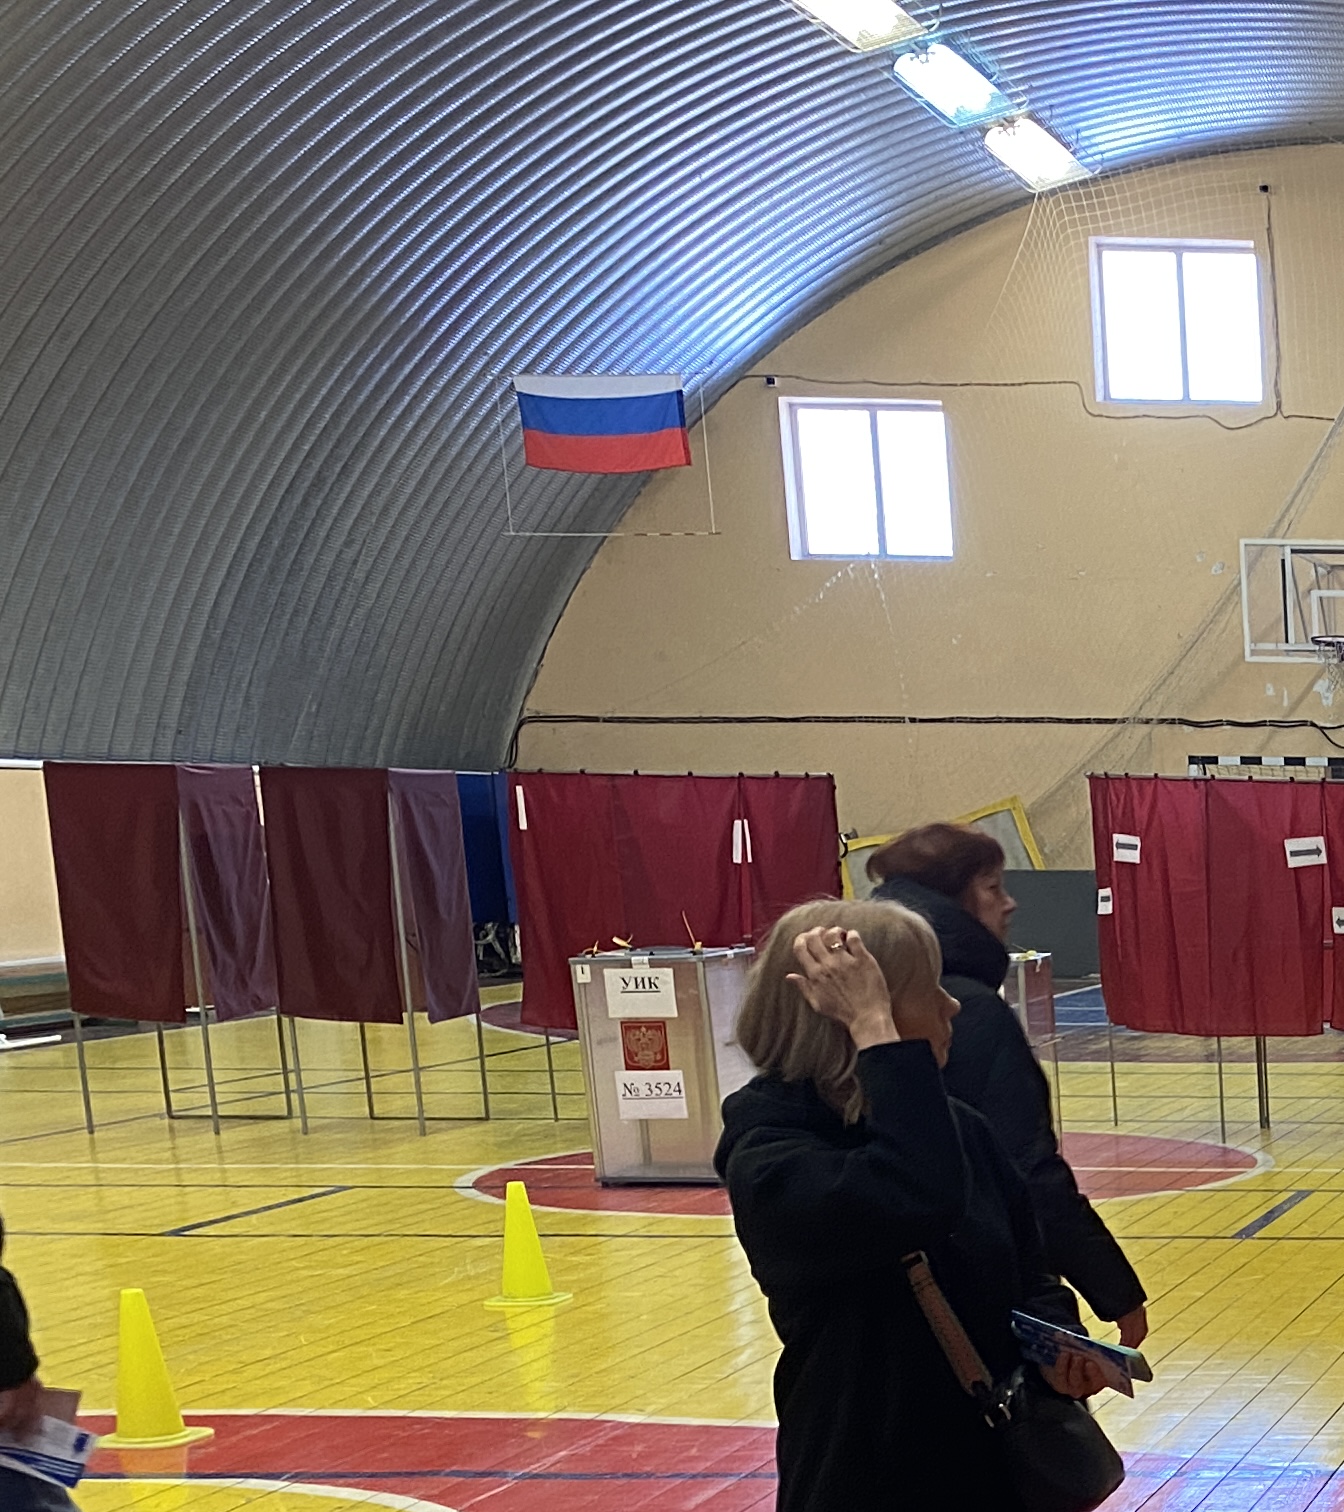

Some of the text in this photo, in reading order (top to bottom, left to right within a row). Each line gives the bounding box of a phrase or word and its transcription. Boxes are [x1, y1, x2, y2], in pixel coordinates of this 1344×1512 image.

[619, 976, 660, 991] УИК
[622, 1081, 682, 1098] № 3524
